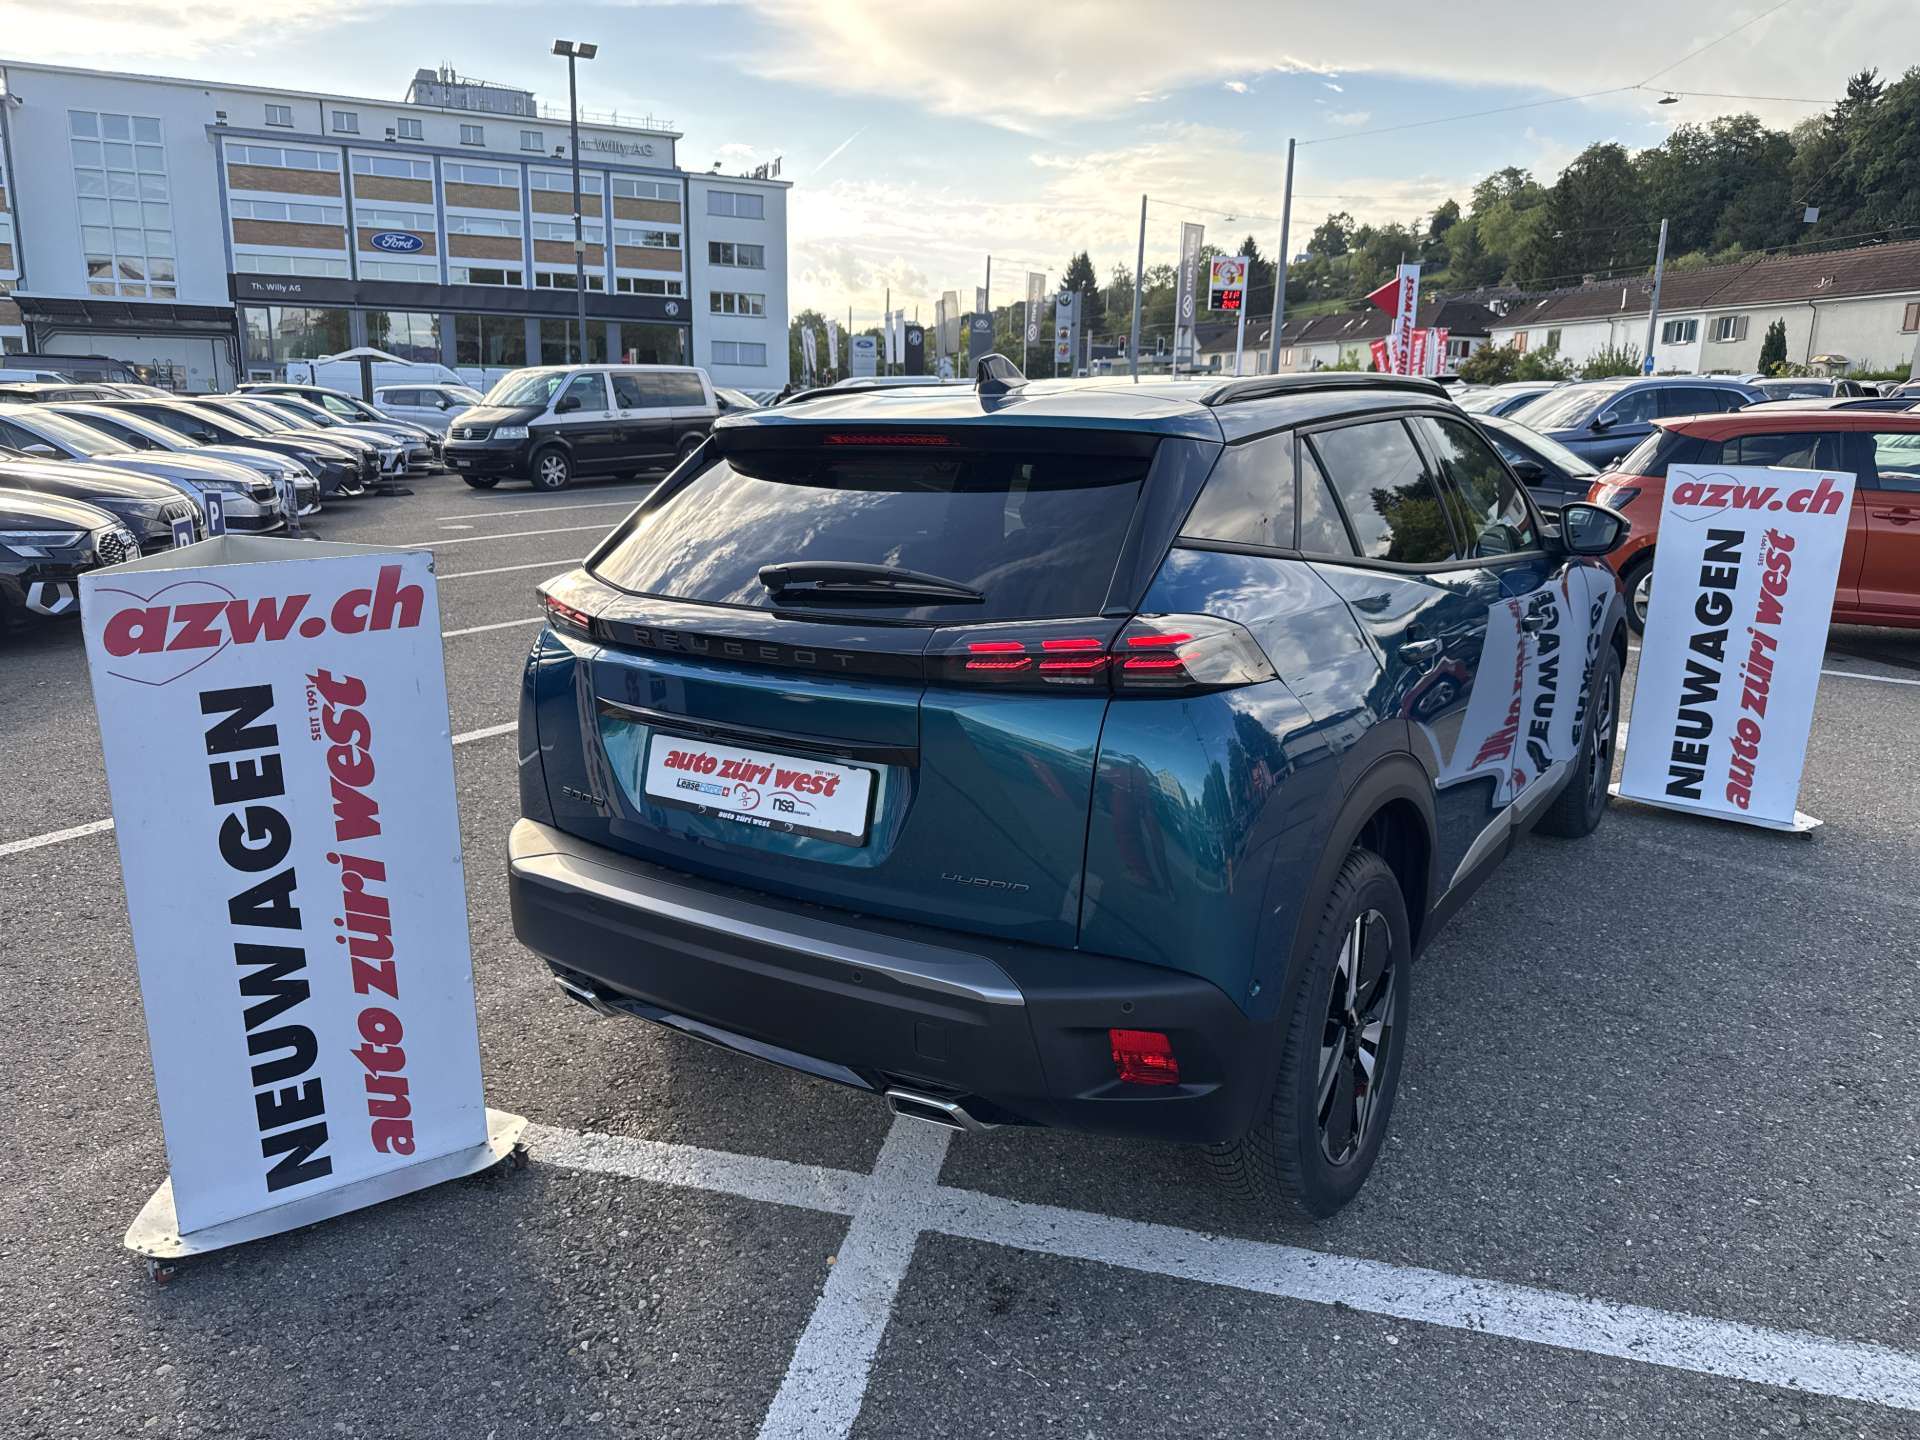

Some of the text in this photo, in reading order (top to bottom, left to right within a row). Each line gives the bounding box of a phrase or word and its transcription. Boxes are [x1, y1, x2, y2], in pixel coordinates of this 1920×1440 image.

[381, 234, 414, 249] Ford
[250, 282, 302, 293] Th. Willy AG
[208, 500, 220, 531] P
[1672, 478, 1845, 515] azw.ch
[103, 564, 425, 657] azw.ch
[633, 629, 855, 667] PEUGEOT
[1665, 528, 1746, 801] NEUWAGEN
[1725, 528, 1796, 810] auto züri west
[305, 684, 322, 742] SEIT 1991
[663, 750, 841, 798] auto züri west
[717, 811, 735, 821] auto
[752, 818, 771, 828] west
[772, 797, 795, 813] nsa
[305, 668, 416, 1157] auto züri west
[199, 683, 334, 1193] NEUWAGEN
